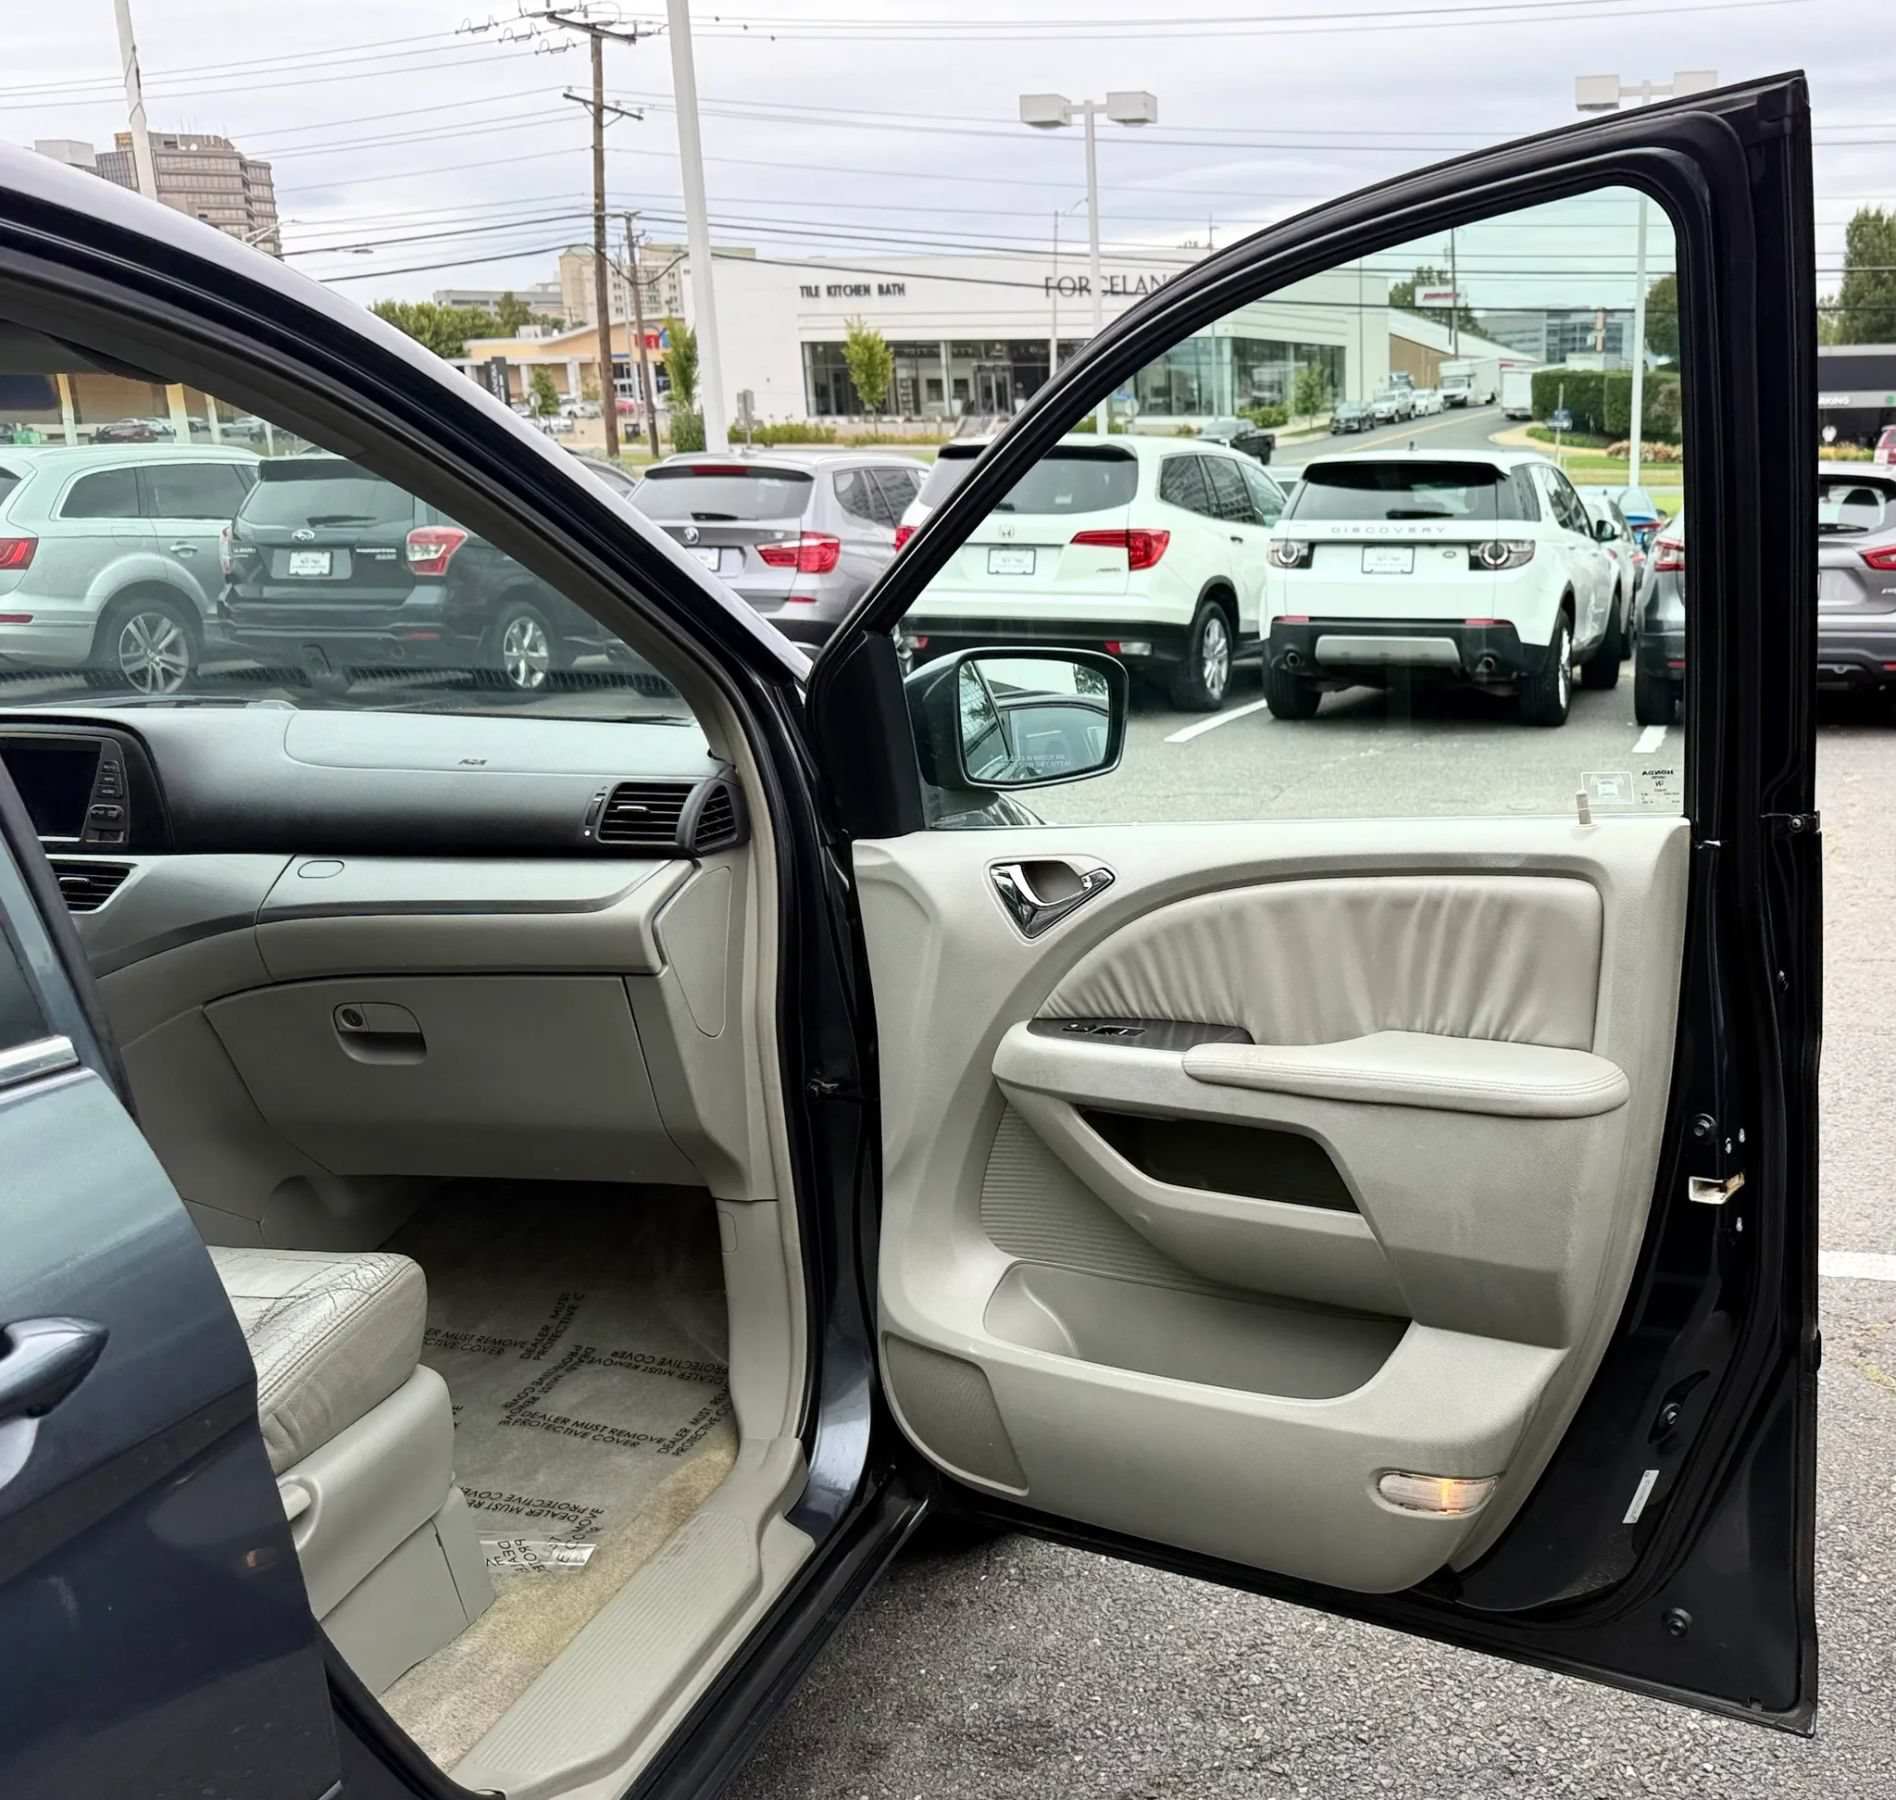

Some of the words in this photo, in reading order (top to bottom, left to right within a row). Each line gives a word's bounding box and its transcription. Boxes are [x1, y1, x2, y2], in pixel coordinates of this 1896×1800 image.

[799, 285, 820, 298] TILE
[826, 284, 871, 298] KITCHEN
[877, 283, 905, 297] BATH
[1331, 526, 1447, 534] DISCOVERY
[475, 1335, 530, 1349] REMOVE
[511, 1418, 593, 1439] PROTECTIVE
[592, 1433, 641, 1448] COVER
[520, 1410, 571, 1425] DEALER
[571, 1420, 609, 1434] MUST
[608, 1426, 667, 1445] REMOVE
[484, 1502, 525, 1515] MUST
[505, 1493, 589, 1514] PROTECTIVE
[526, 1509, 579, 1523] DEALER
